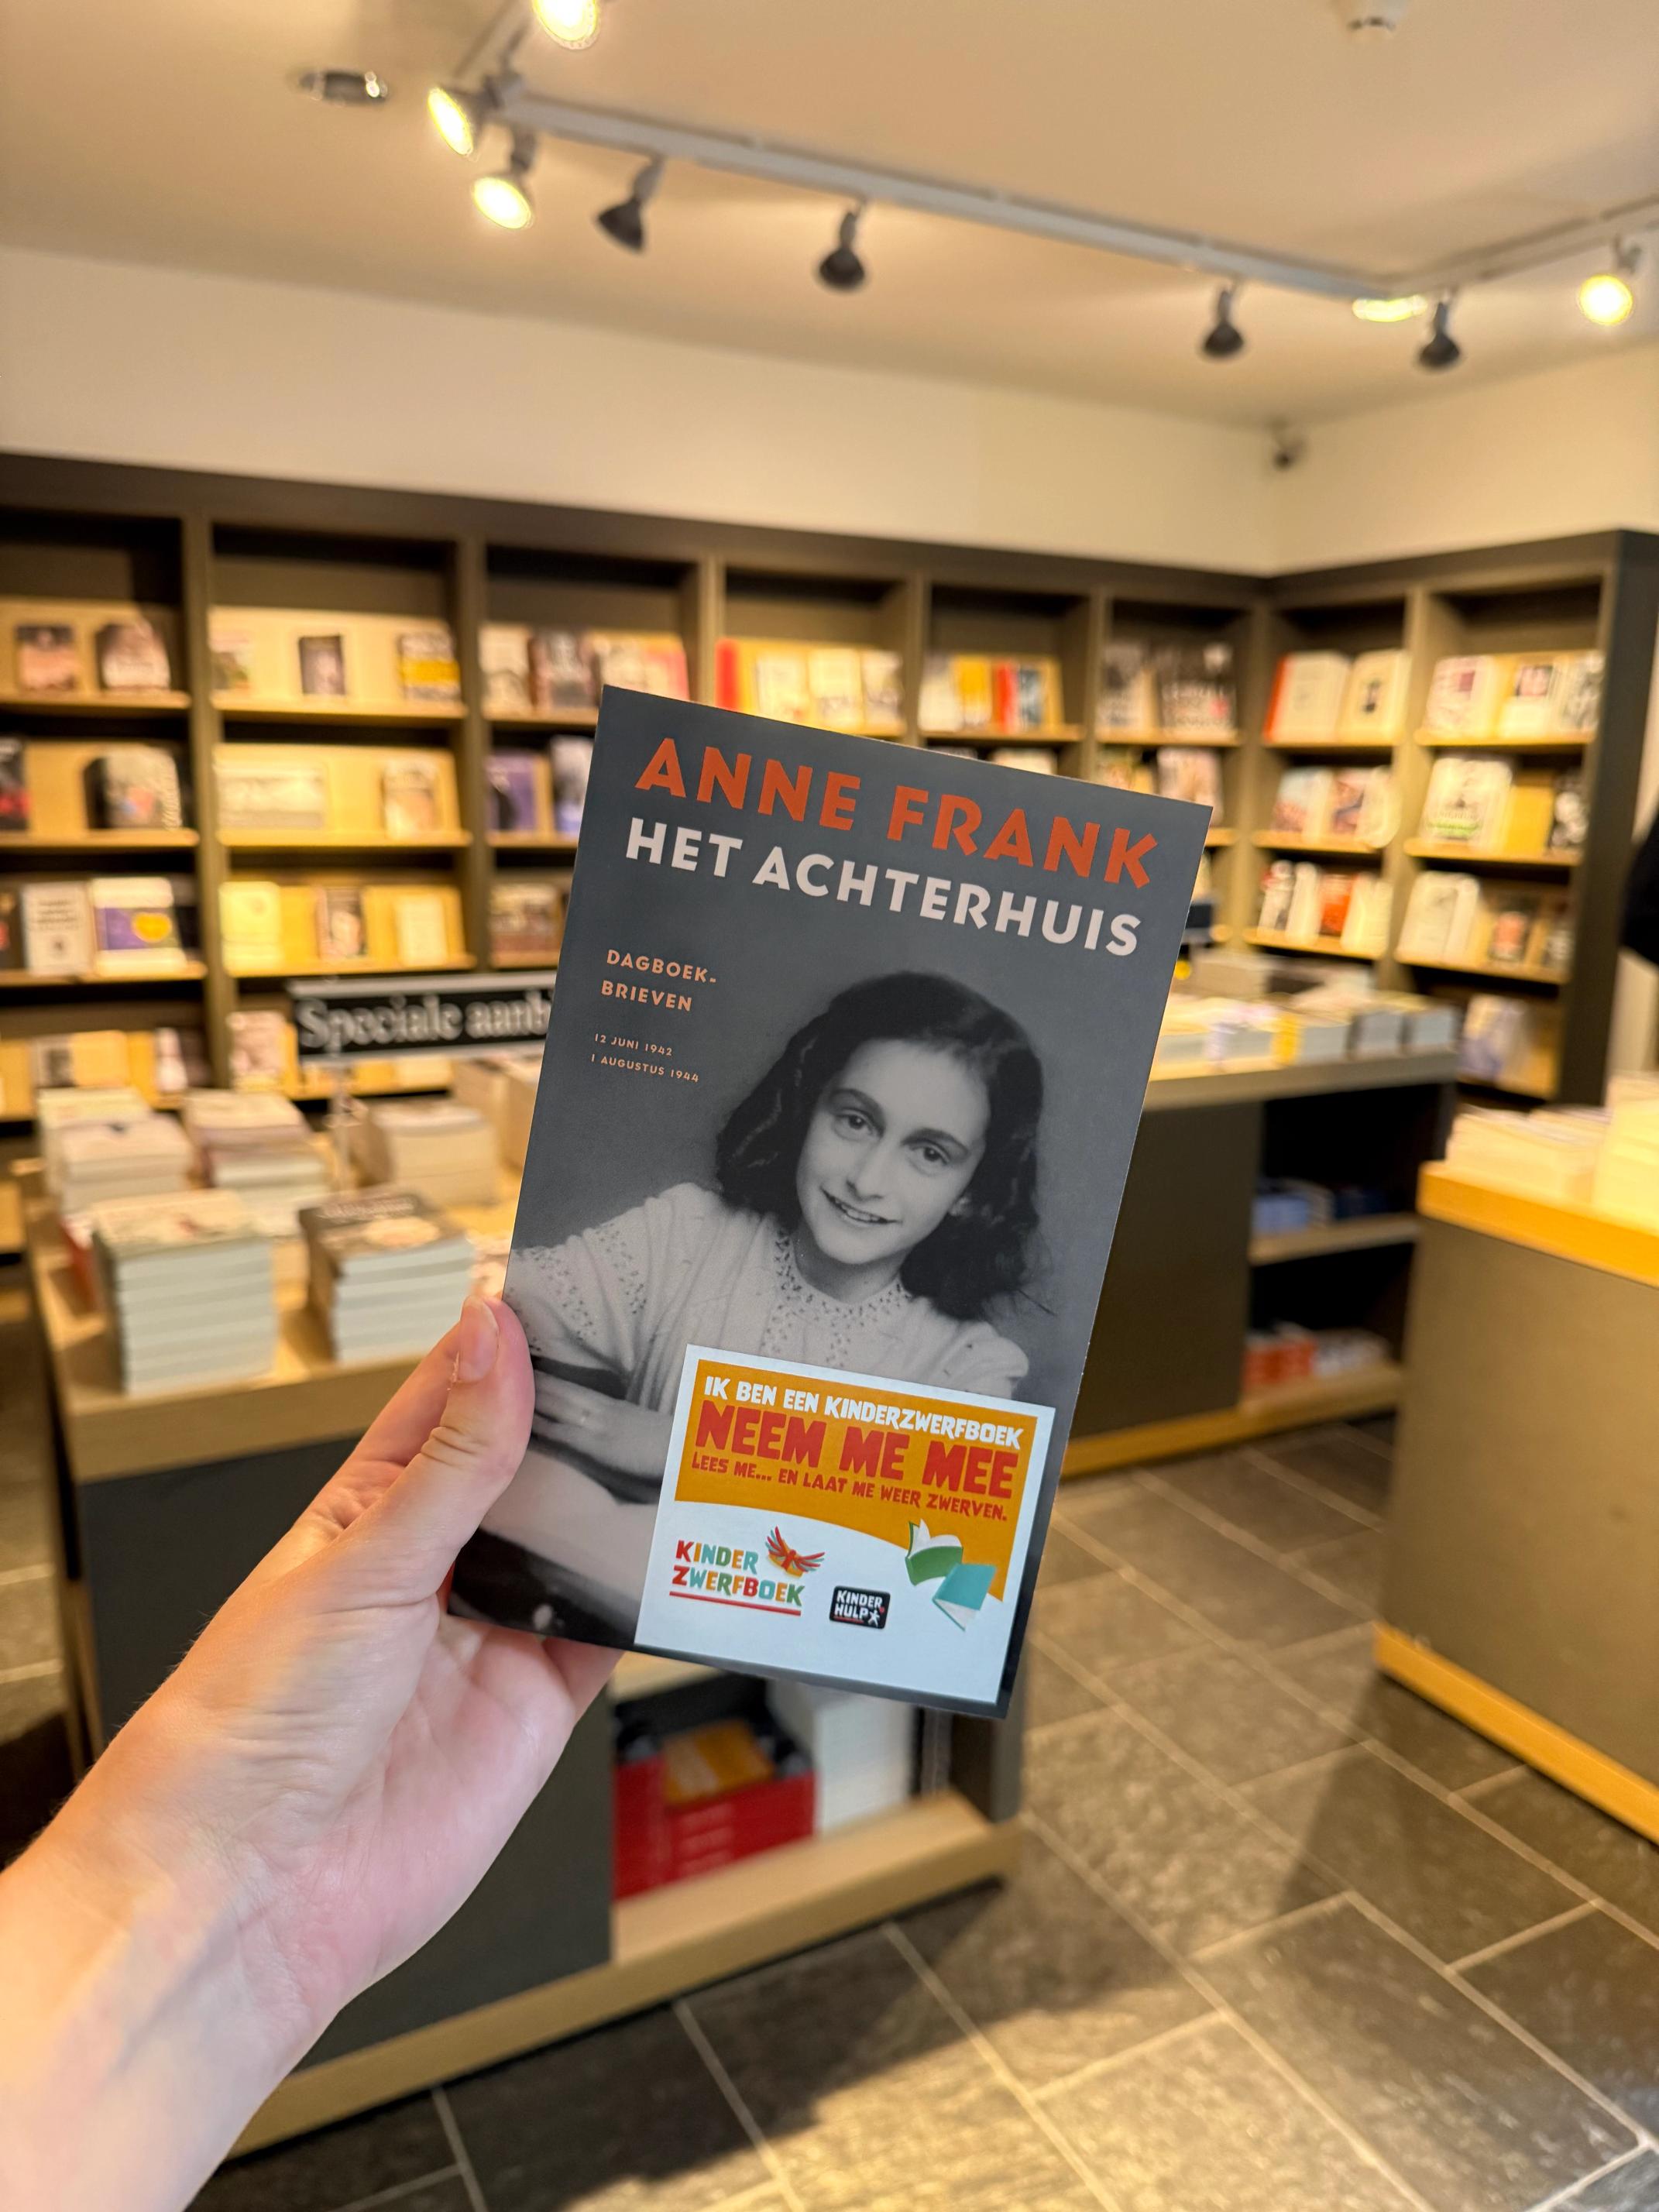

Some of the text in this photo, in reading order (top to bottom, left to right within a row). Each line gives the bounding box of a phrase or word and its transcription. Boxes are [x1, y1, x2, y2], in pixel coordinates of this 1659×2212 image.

[634, 737, 1159, 888] ANNE FRANK
[625, 817, 1142, 957] HET ACHTERHUIS
[606, 949, 716, 984] DAGBOEK-
[601, 980, 692, 1012] BRIEVEN
[296, 991, 553, 1056] Speciale aanb
[594, 1032, 673, 1056] 12 JUNI 1942
[600, 1056, 665, 1076] AUGUSTUS
[670, 1069, 699, 1083] 1944
[704, 1376, 1025, 1450] IK BEN EEN KINDERZWERFBOEK
[696, 1400, 1019, 1499] NEEM ME MEE
[692, 1451, 1008, 1521] LEES ME... EN LAAT ME WEER ZWERVEN.
[675, 1539, 759, 1575] KINDER
[672, 1564, 805, 1606] ZWERFBOEK
[836, 1589, 884, 1609] KINDER
[834, 1602, 869, 1620] HULP
